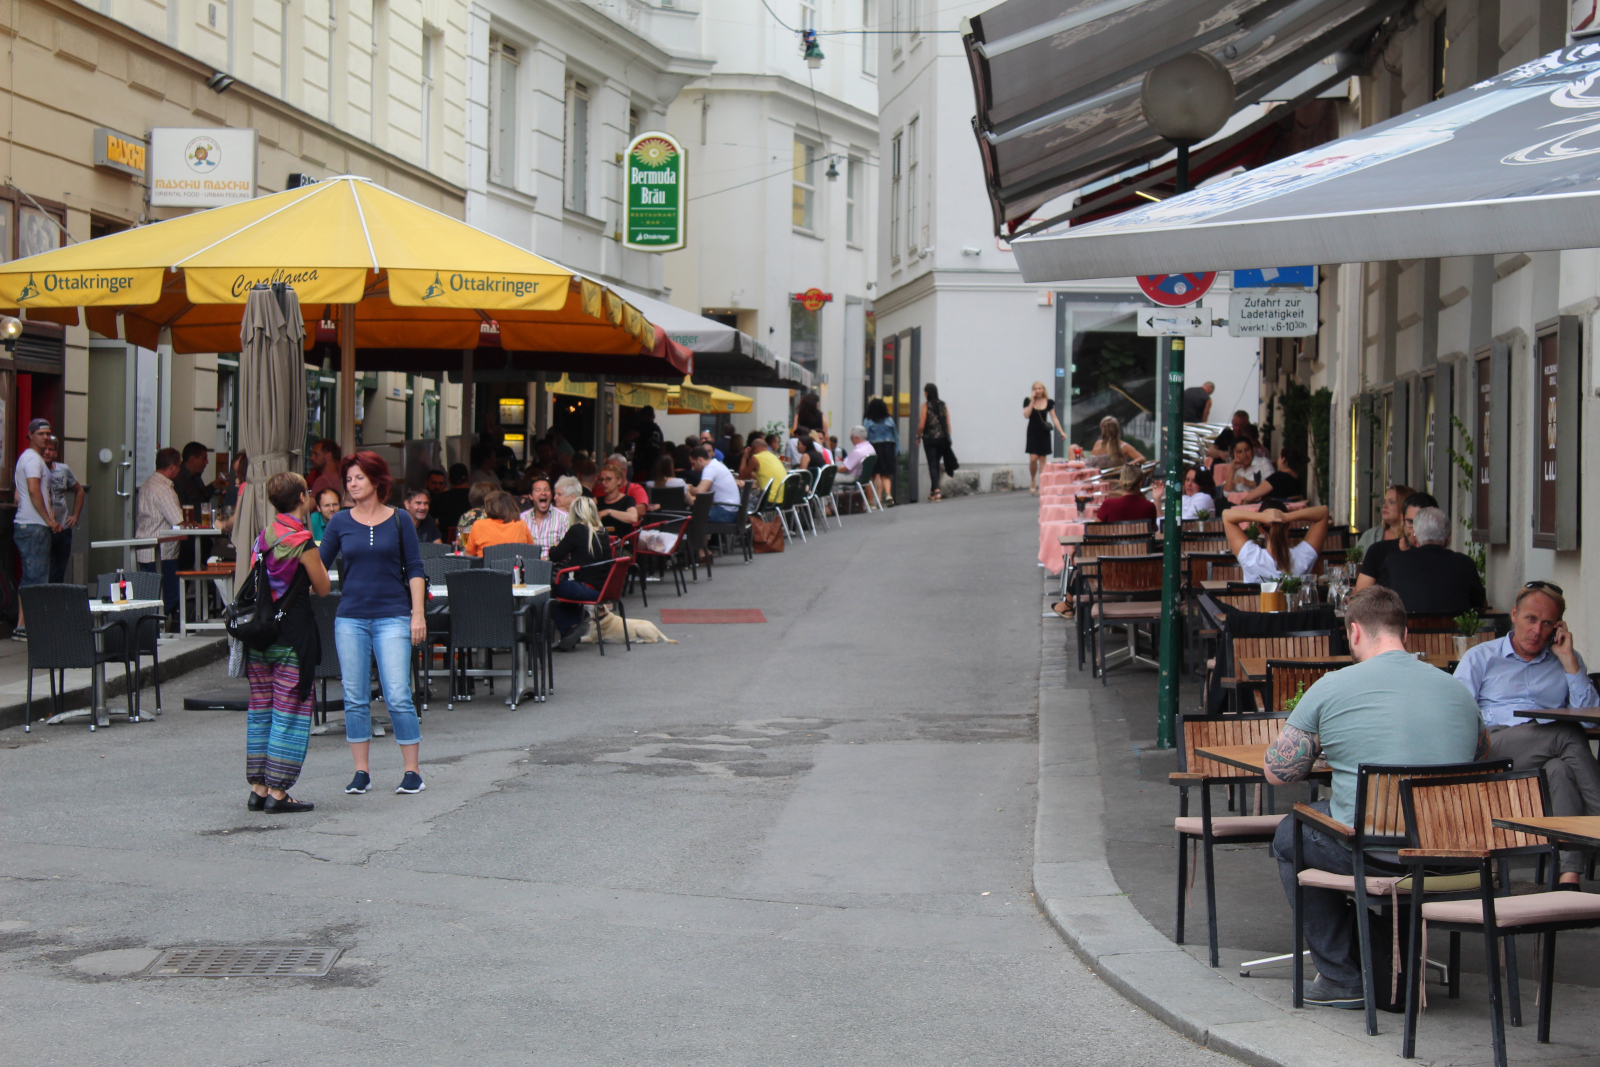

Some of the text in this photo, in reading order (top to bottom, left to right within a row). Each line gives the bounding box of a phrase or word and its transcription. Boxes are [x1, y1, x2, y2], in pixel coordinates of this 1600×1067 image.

[631, 167, 676, 184] Bermuda
[641, 186, 666, 204] Bräu
[44, 273, 134, 293] Ottakringer
[231, 268, 319, 298] Casablanca
[449, 272, 540, 297] Ottakringer
[1244, 297, 1301, 308] Zufahrt zur
[1241, 309, 1304, 320] Ladetätigkeit
